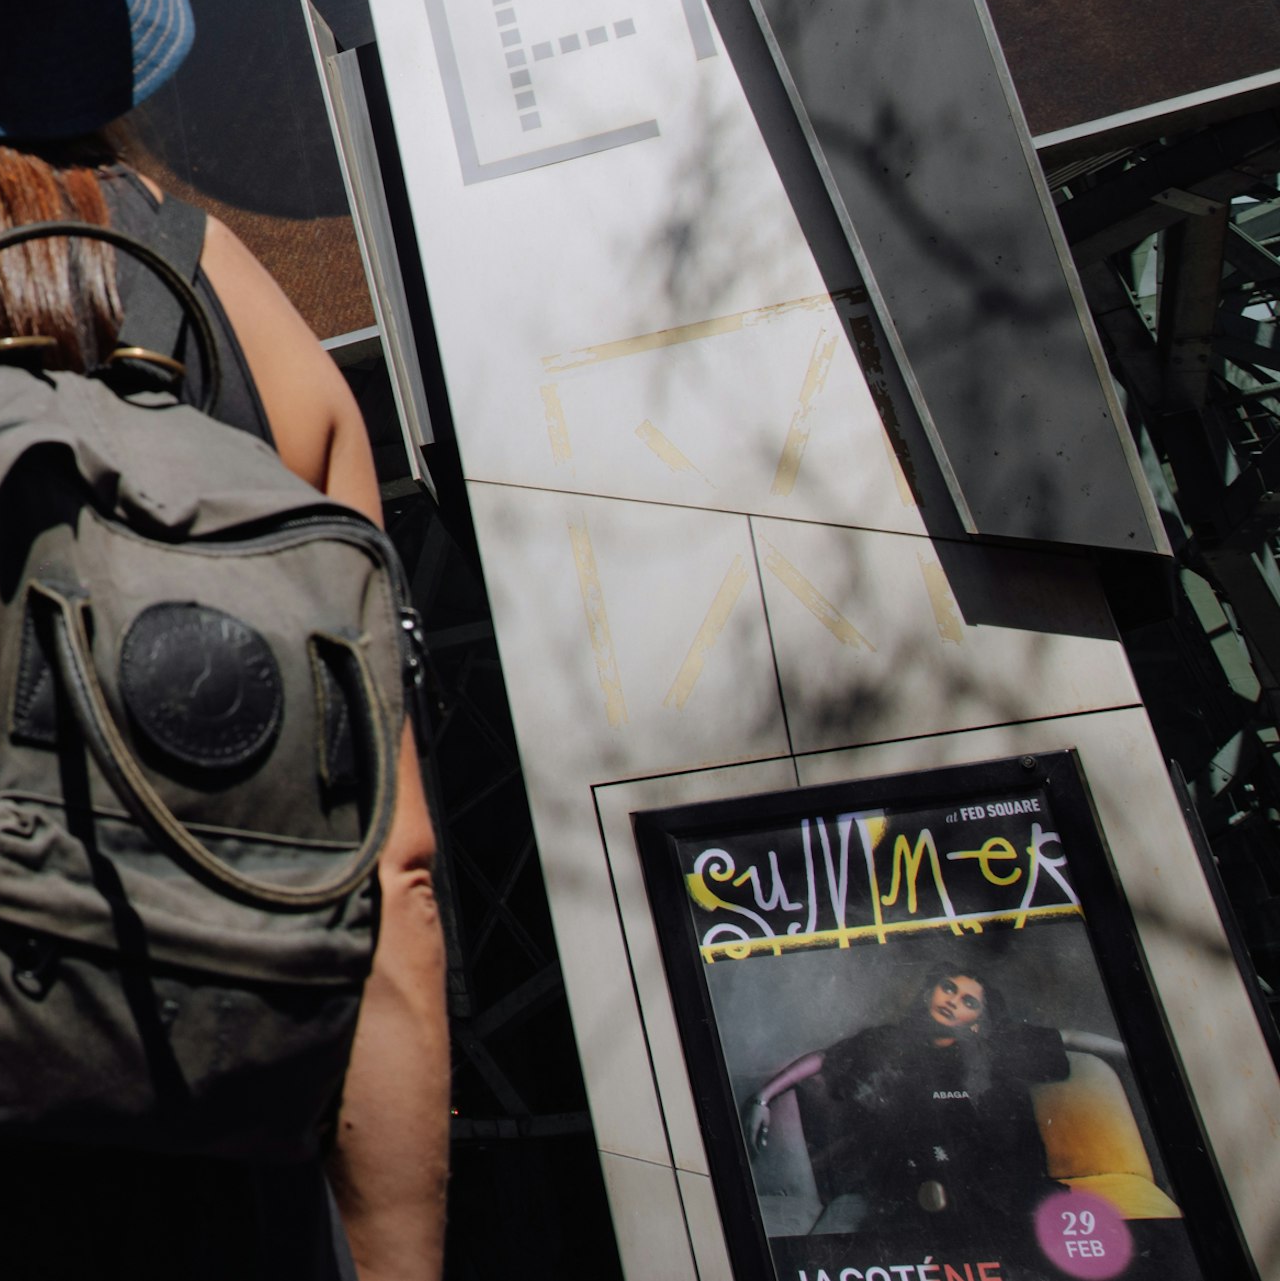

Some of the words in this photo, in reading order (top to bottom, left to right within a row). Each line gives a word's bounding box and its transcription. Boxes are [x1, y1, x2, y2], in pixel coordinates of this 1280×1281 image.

[945, 812, 958, 823] at
[960, 805, 986, 821] FED
[987, 798, 1041, 818] SQUARE
[1060, 1210, 1095, 1235] 29
[1065, 1239, 1105, 1258] FEB
